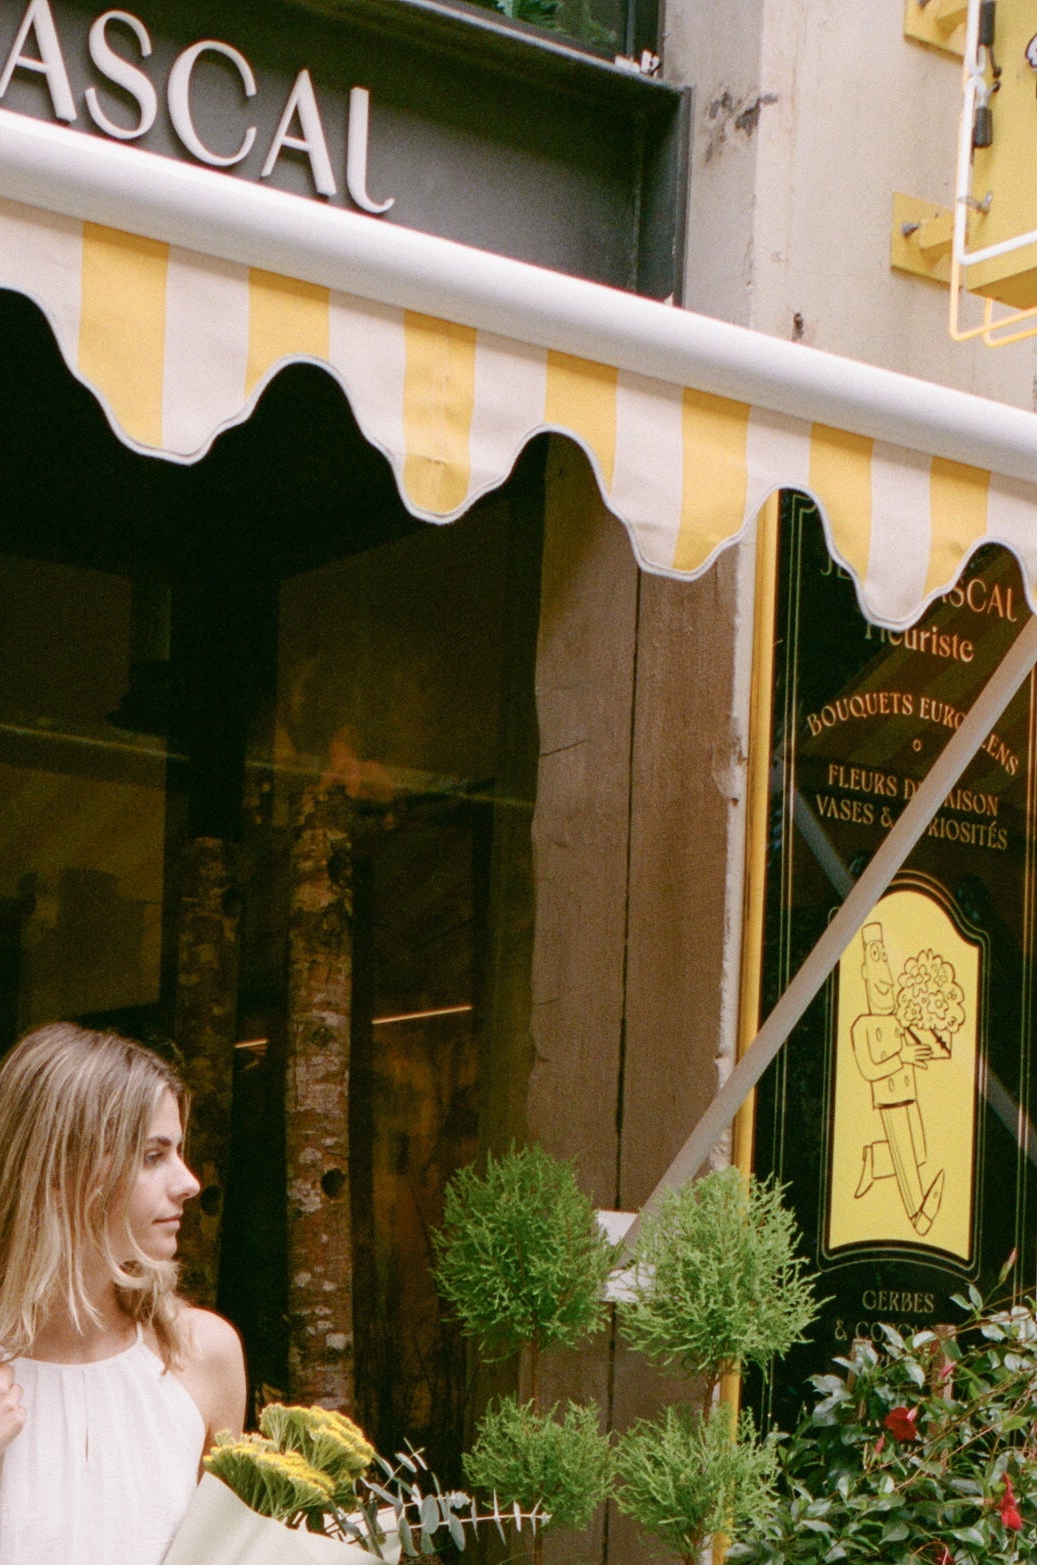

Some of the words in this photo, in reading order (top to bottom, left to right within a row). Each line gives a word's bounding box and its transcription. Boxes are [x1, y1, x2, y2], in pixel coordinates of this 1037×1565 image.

[806, 692, 912, 737] BOUQUETS
[919, 697, 1019, 776] EUROENS
[828, 764, 899, 797] FLEURS
[816, 794, 874, 825] VASES
[928, 815, 1008, 850] RIOSITÉS
